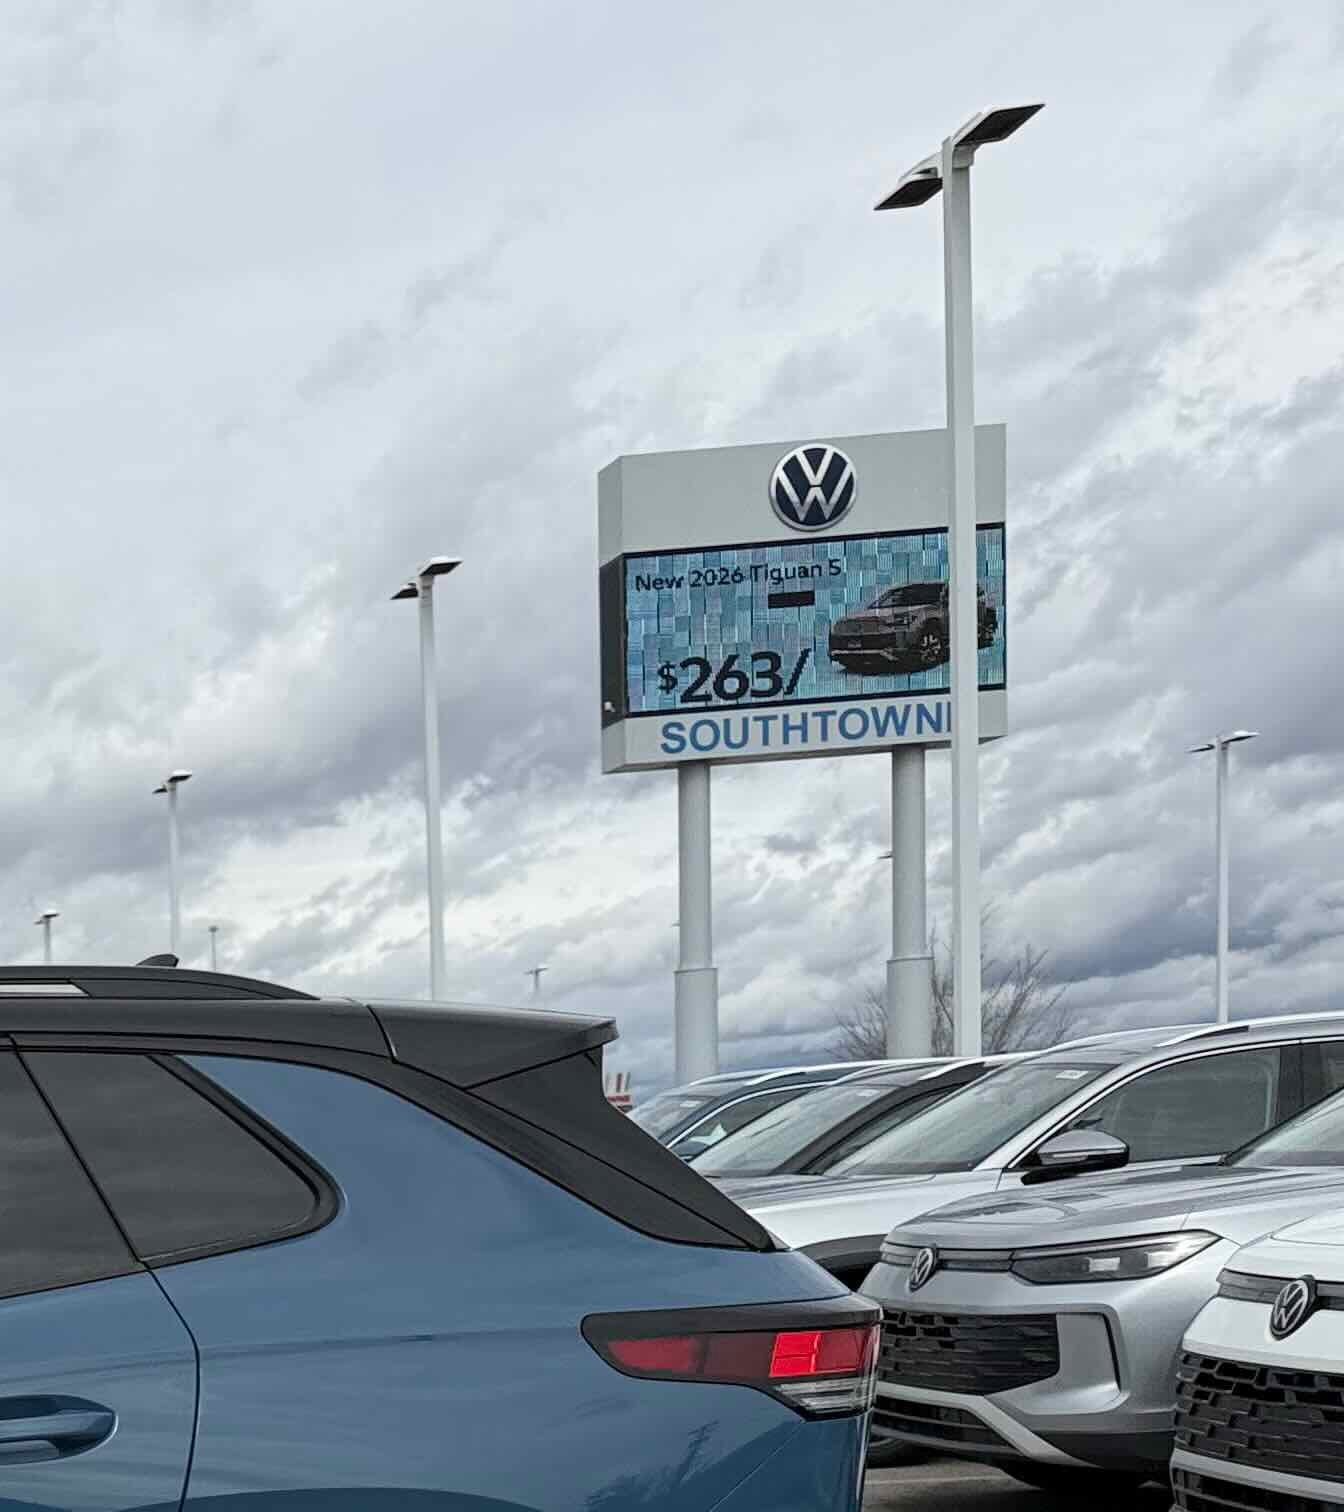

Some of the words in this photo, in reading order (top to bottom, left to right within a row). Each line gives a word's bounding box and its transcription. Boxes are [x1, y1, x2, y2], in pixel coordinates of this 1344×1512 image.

[771, 445, 854, 526] VW
[635, 574, 684, 592] New
[689, 567, 746, 588] 2026
[750, 563, 823, 585] Tiguan
[661, 701, 951, 753] SOUTHTOWN
